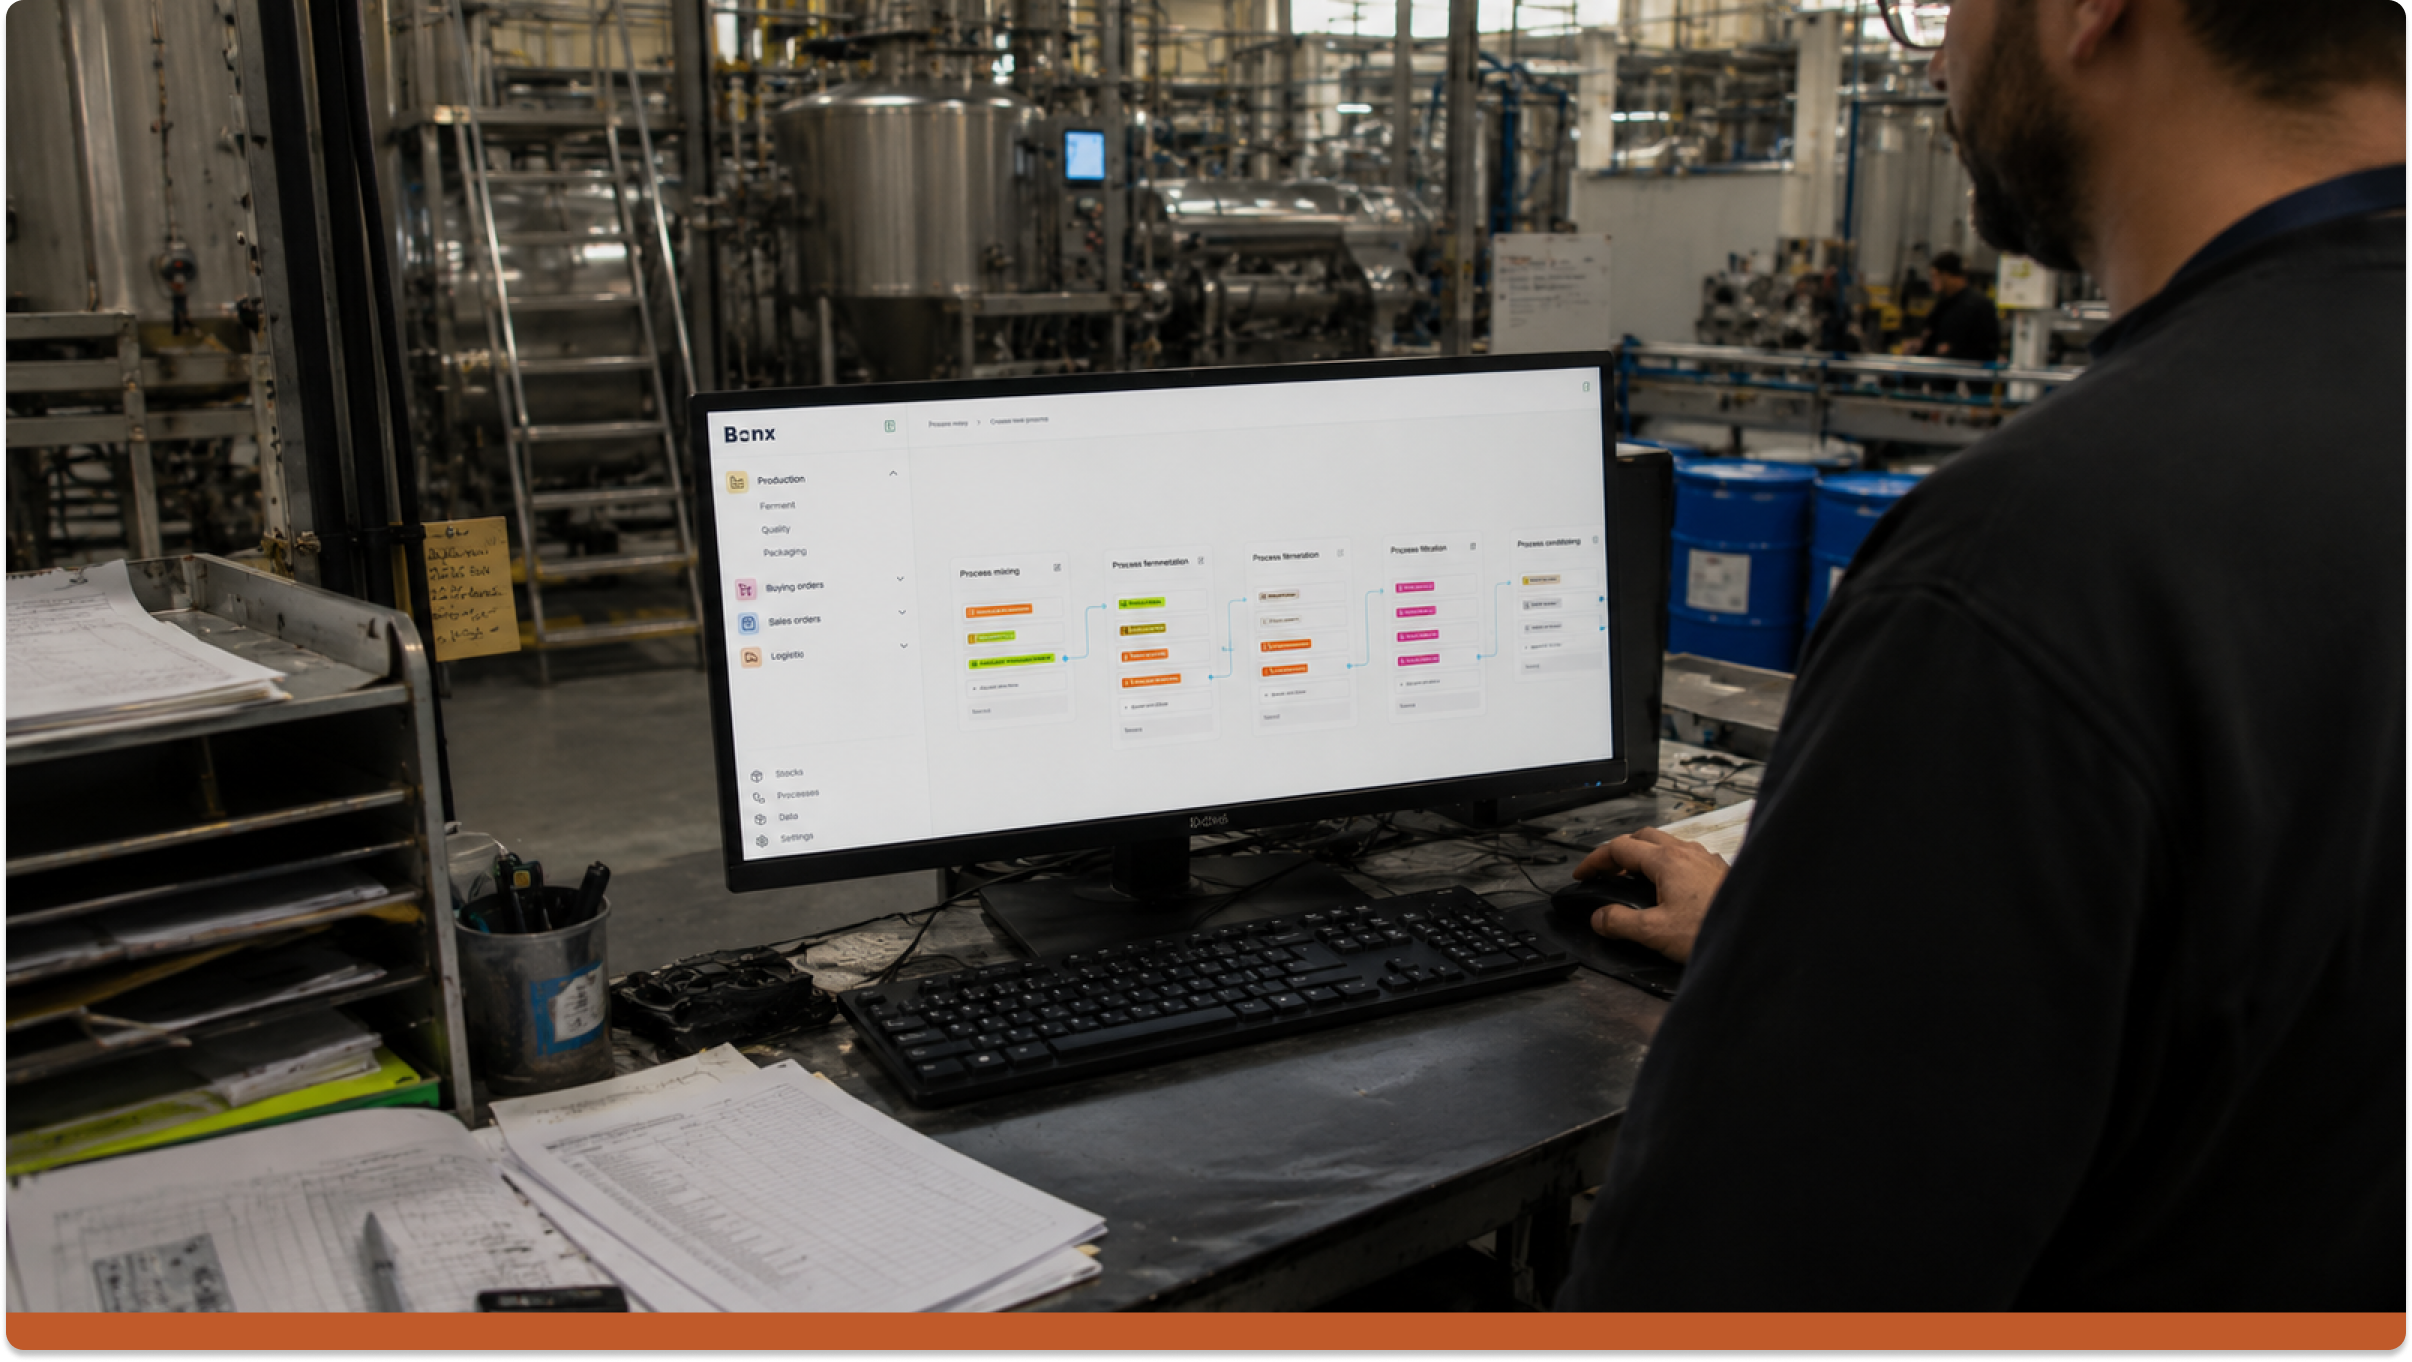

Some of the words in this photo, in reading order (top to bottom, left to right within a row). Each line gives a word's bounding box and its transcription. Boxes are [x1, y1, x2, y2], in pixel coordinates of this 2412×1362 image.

[724, 426, 775, 443] Bonx
[757, 475, 805, 485] Production
[760, 500, 795, 510] Ferment
[762, 524, 791, 535] Quality
[763, 548, 807, 558] Packaging
[960, 569, 992, 578] Process
[766, 583, 795, 593] Buying
[797, 581, 824, 590] orders
[768, 617, 792, 627] Sales
[793, 615, 821, 624] orders
[781, 832, 813, 843] Settings
